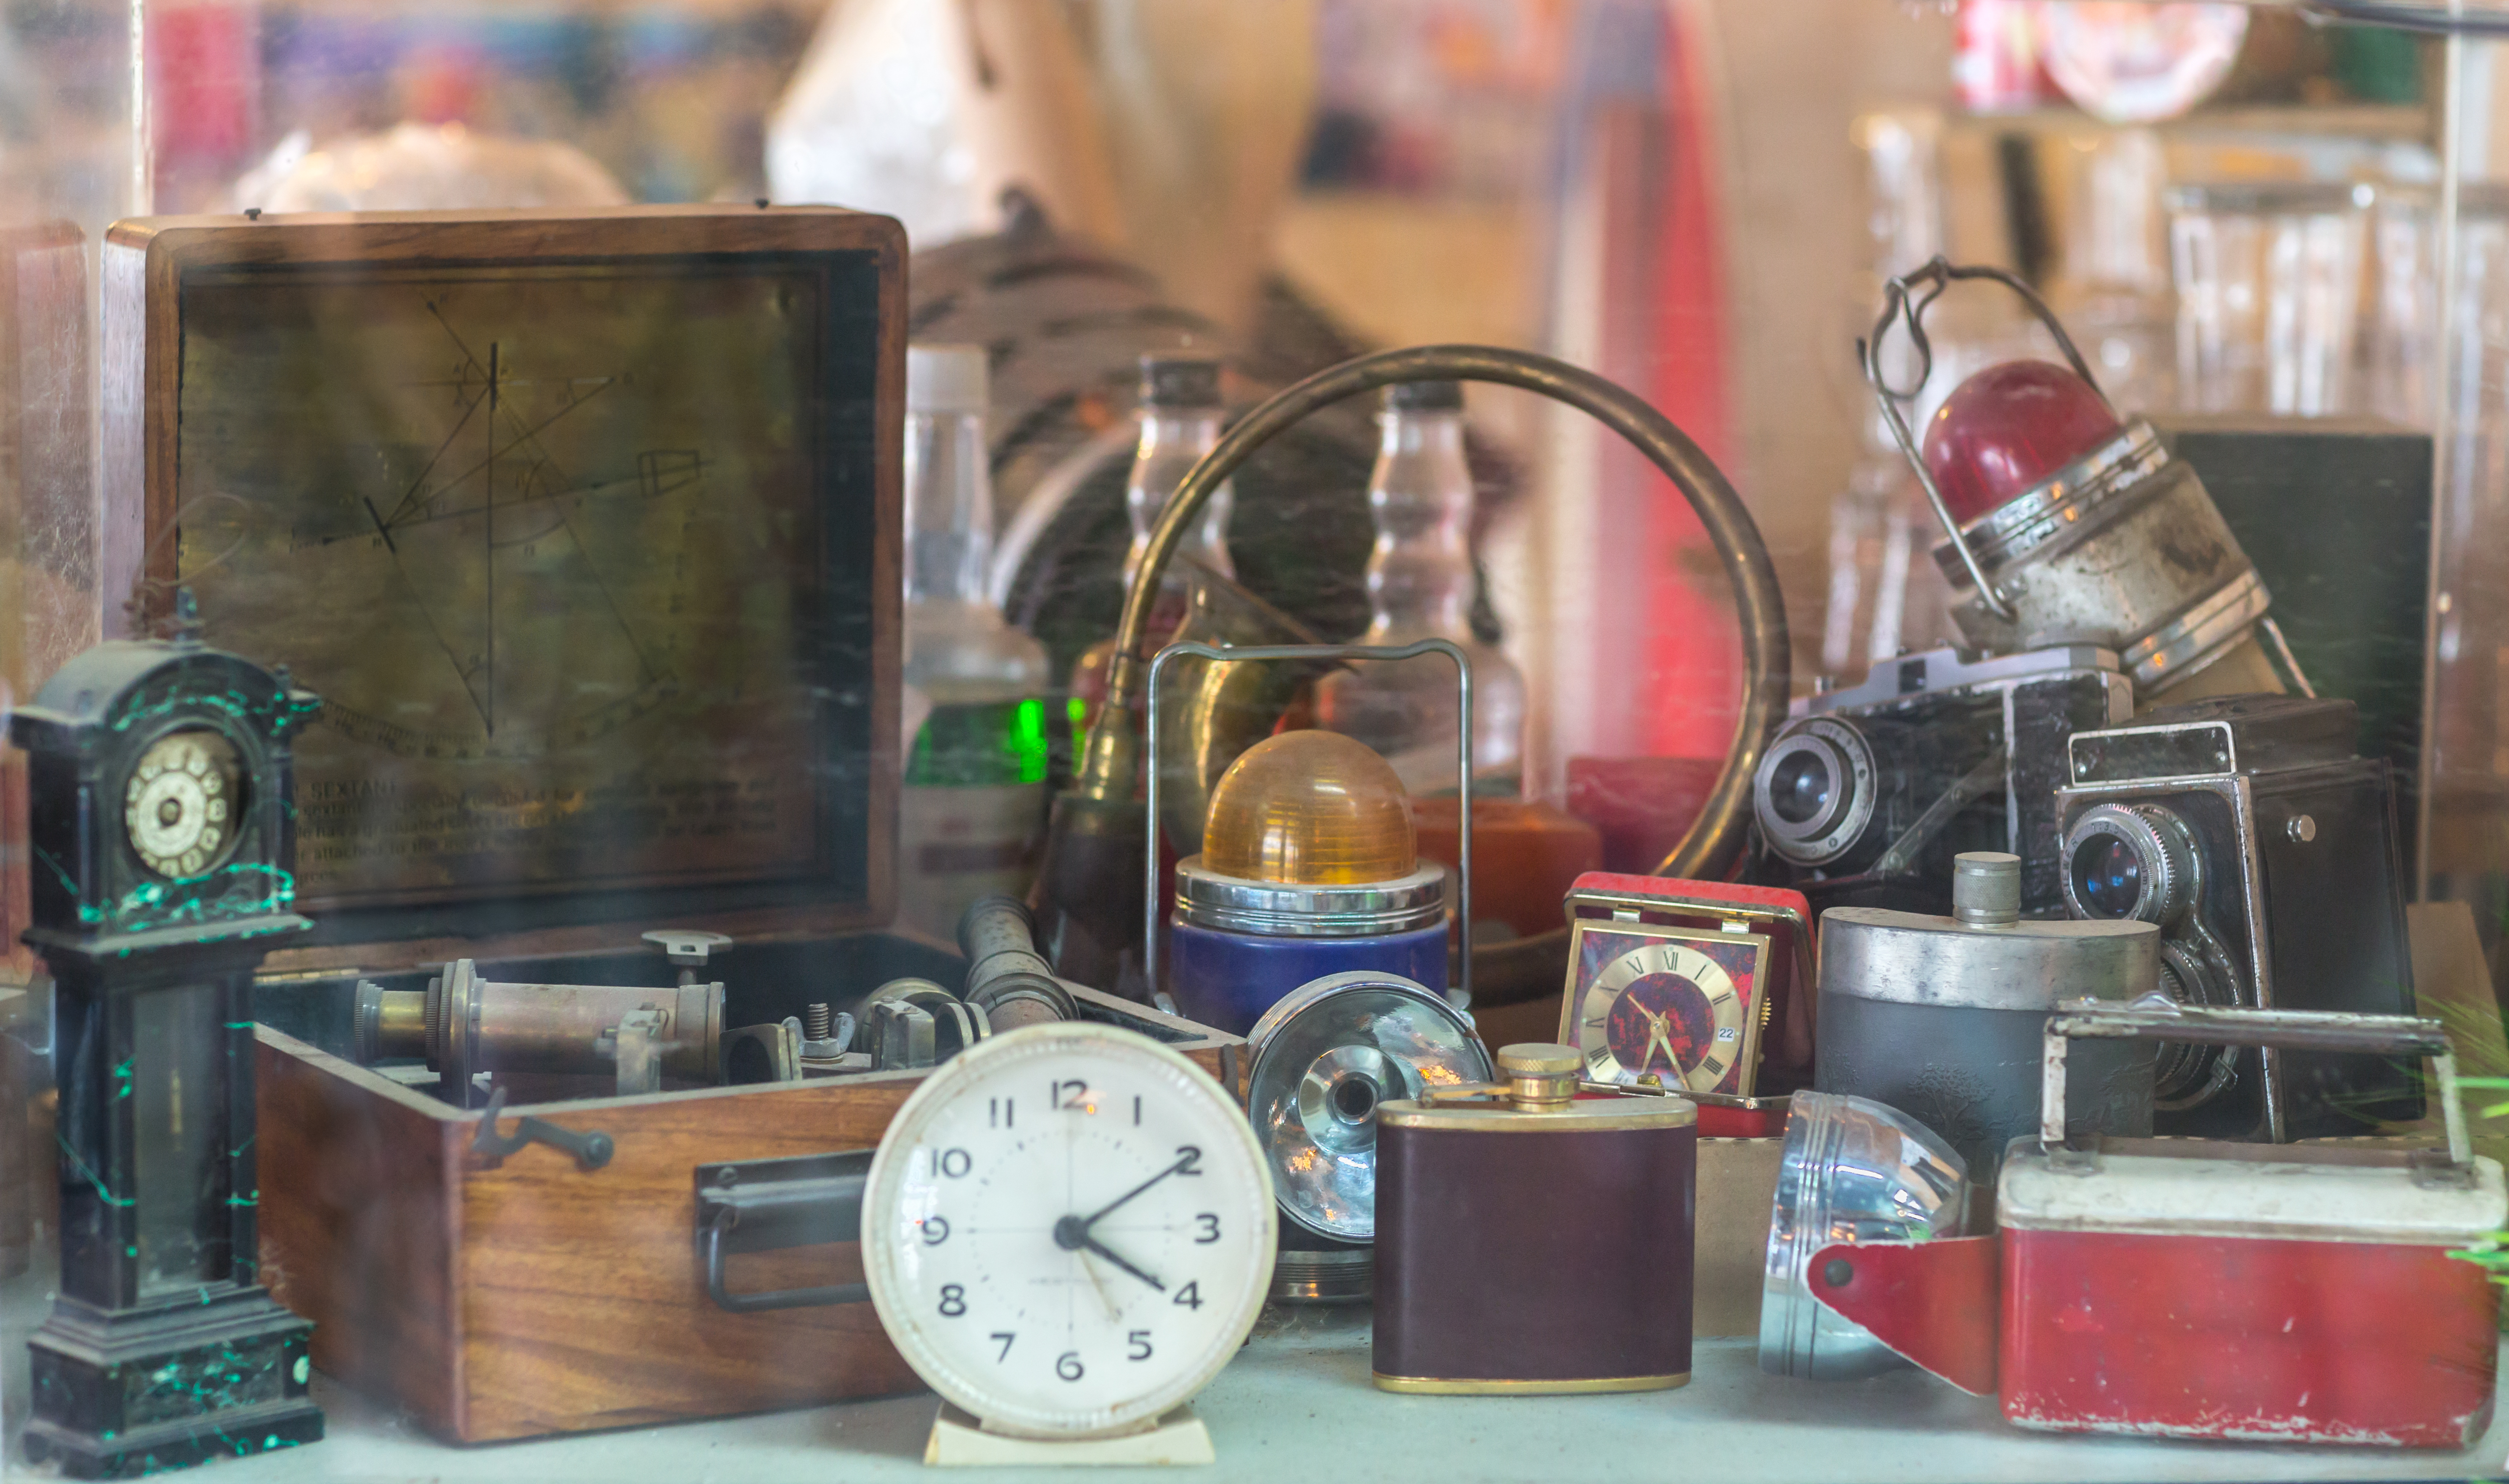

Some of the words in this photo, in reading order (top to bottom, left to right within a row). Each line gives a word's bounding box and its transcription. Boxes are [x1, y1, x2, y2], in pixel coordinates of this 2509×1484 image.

[2062, 838, 2078, 897] VIEWER
[1719, 1028, 1734, 1038] 22
[1051, 1080, 1089, 1110] 12
[1133, 1095, 1142, 1126] 1
[990, 1097, 1014, 1128] 11
[932, 1148, 972, 1178] 10
[1175, 1146, 1203, 1176] 2
[921, 1216, 950, 1246] 9
[1195, 1213, 1221, 1244] 3
[938, 1284, 967, 1317] 8
[1173, 1280, 1204, 1311] 4
[990, 1332, 1016, 1363] 7
[1127, 1330, 1153, 1361] 5
[1055, 1351, 1085, 1382] 6
